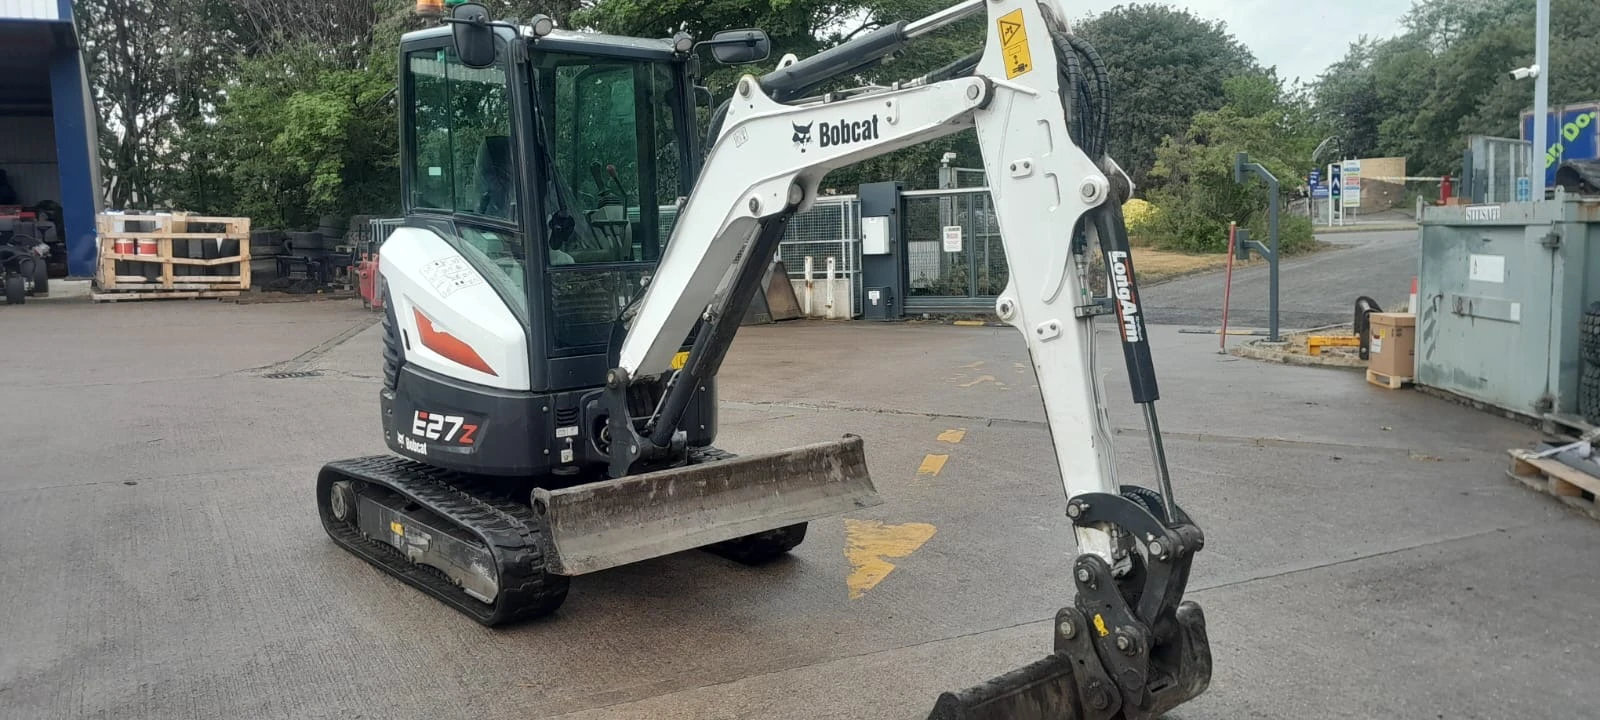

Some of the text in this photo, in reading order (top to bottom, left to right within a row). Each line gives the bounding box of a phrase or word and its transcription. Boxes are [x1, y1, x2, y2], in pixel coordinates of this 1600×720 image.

[819, 114, 879, 148] Bobcat
[1108, 251, 1138, 342] LongArm
[405, 437, 427, 456] Bobcat
